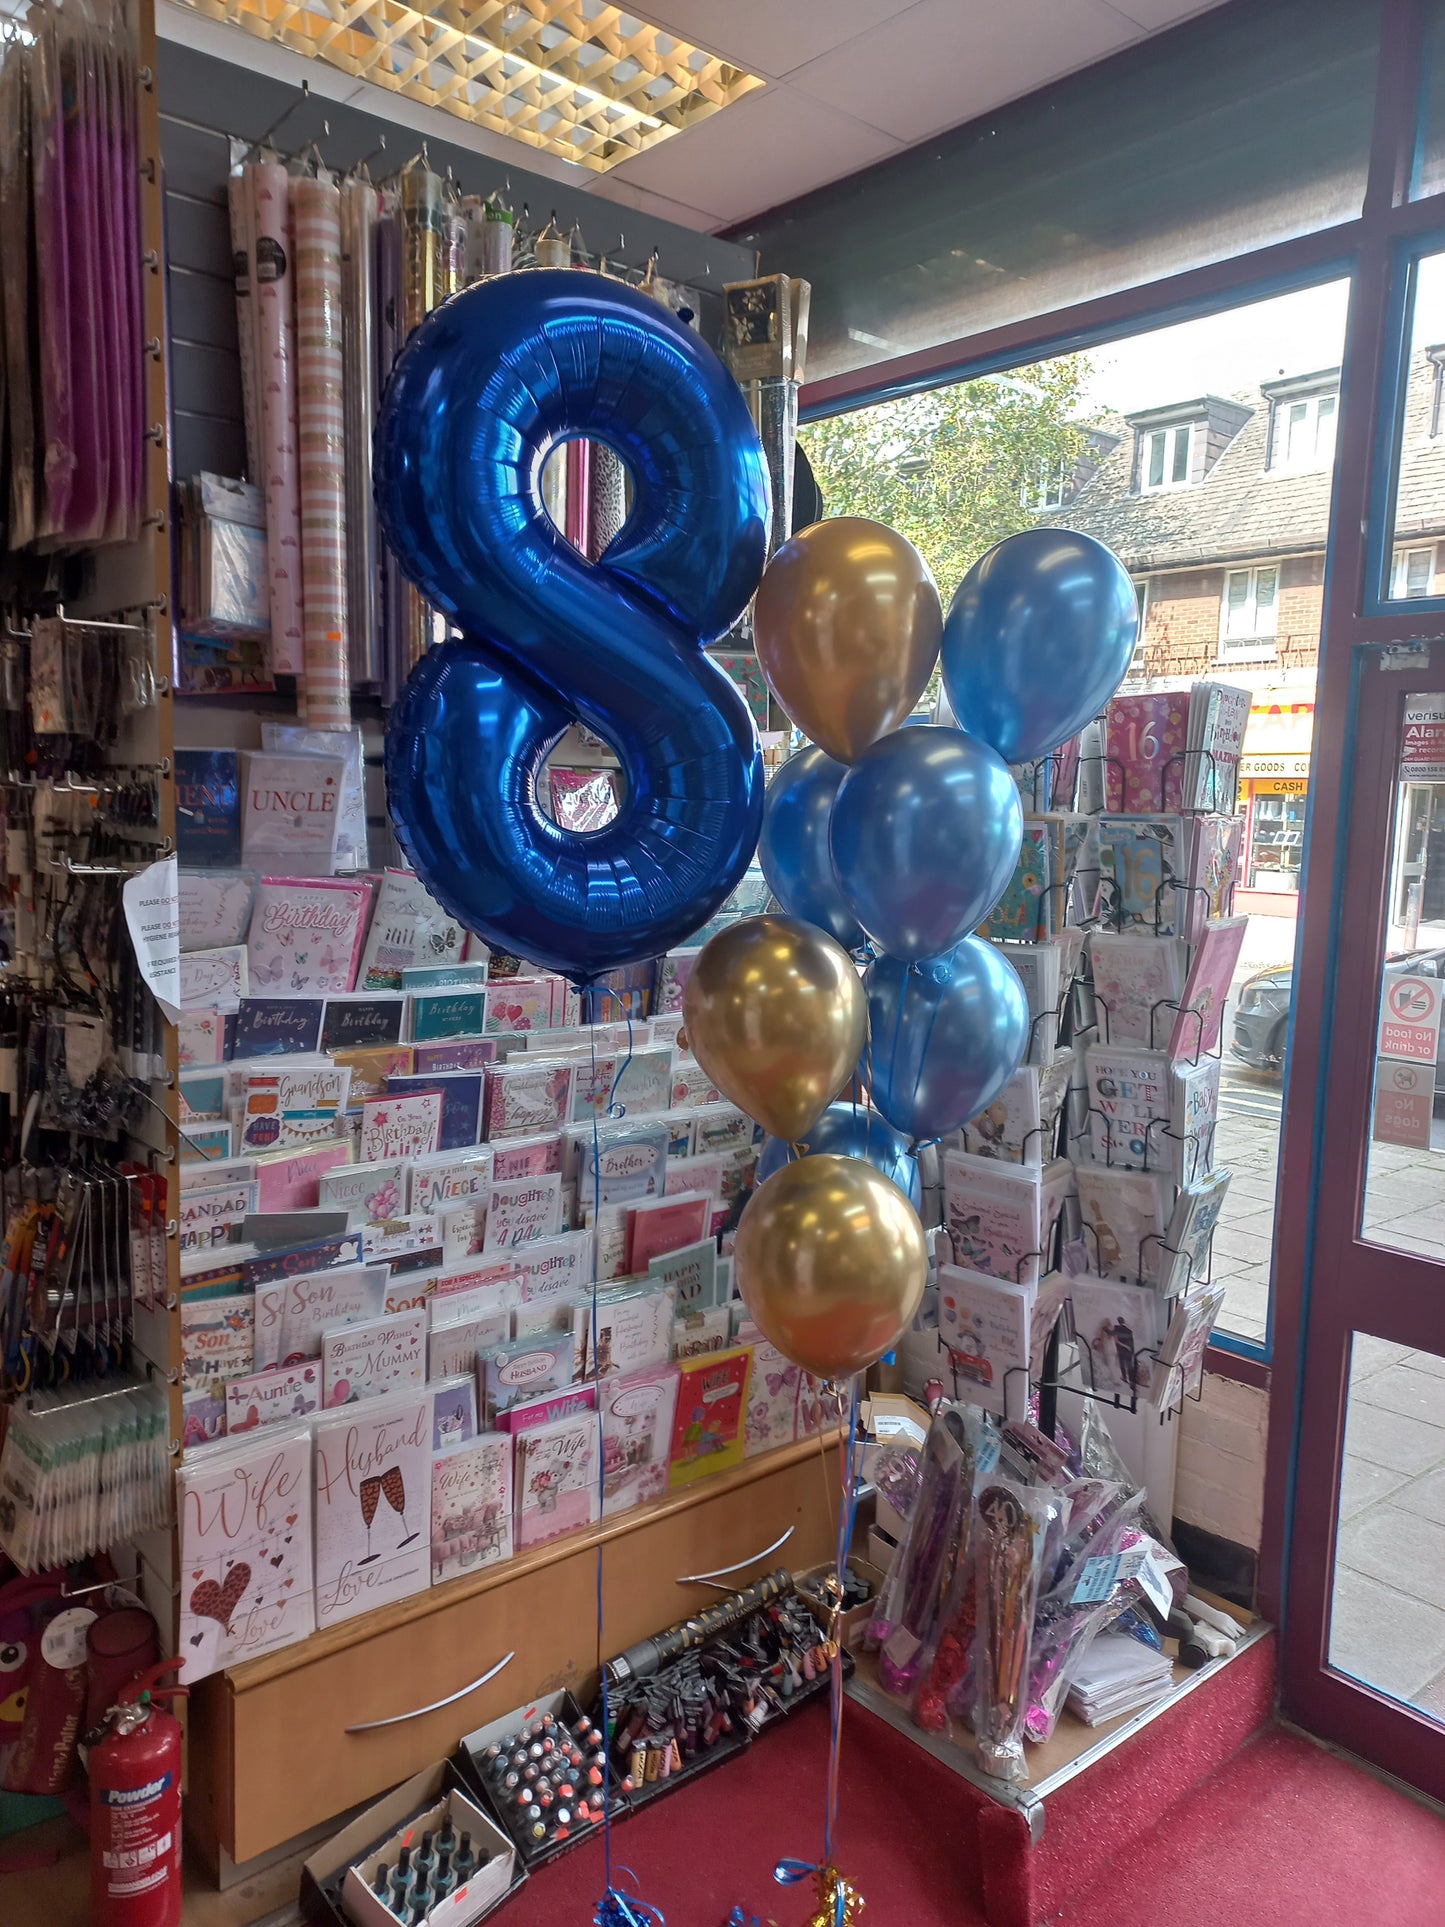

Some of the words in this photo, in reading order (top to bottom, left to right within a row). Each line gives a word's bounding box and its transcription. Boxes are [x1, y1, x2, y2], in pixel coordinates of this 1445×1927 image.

[1125, 721, 1160, 762] 16
[1406, 725, 1445, 738] Alar
[1254, 762, 1285, 772] GOODS
[1273, 782, 1303, 791] CASH
[252, 789, 335, 812] UNCLE
[1121, 848, 1159, 900] 16
[138, 899, 160, 907] PLEASE
[141, 923, 161, 931] PLEASE
[264, 901, 354, 938] Birthday
[429, 1001, 476, 1015] Birthday
[252, 1010, 309, 1031] Birthday
[340, 1012, 389, 1030] Birthday
[1130, 1069, 1157, 1081] YOU
[280, 1072, 343, 1107] Grandson
[1096, 1078, 1158, 1103] GET
[1099, 1100, 1160, 1120] WELL
[1193, 1087, 1213, 1116] Baby
[252, 1120, 275, 1130] HAVE
[510, 1106, 554, 1125] happy
[605, 1153, 643, 1173] Brother
[324, 1180, 365, 1203] Niece
[282, 1254, 317, 1276] Son
[663, 1262, 702, 1284] HAPPY
[440, 1278, 452, 1286] FOR
[459, 1273, 482, 1283] SPECIAL
[291, 1279, 338, 1315] Son
[385, 1295, 427, 1315] Son
[312, 1300, 362, 1322] Birthday
[194, 1331, 231, 1351] Son
[330, 1340, 375, 1358] BIRTHDAY
[378, 1329, 413, 1346] WISHES
[354, 1347, 422, 1378] MUMMY
[510, 1364, 547, 1381] HUSBAND
[249, 1377, 303, 1402] Auntie
[702, 1370, 730, 1391] WIFE
[545, 1395, 588, 1422] Wife
[317, 1405, 428, 1505] Husband
[552, 1431, 587, 1458] Wife
[439, 1471, 470, 1490] Wife
[184, 1453, 303, 1539] Wife
[985, 1497, 1017, 1528] 40
[320, 1560, 384, 1615] Love
[232, 1606, 286, 1651] Love
[108, 1776, 166, 1804] Powder
